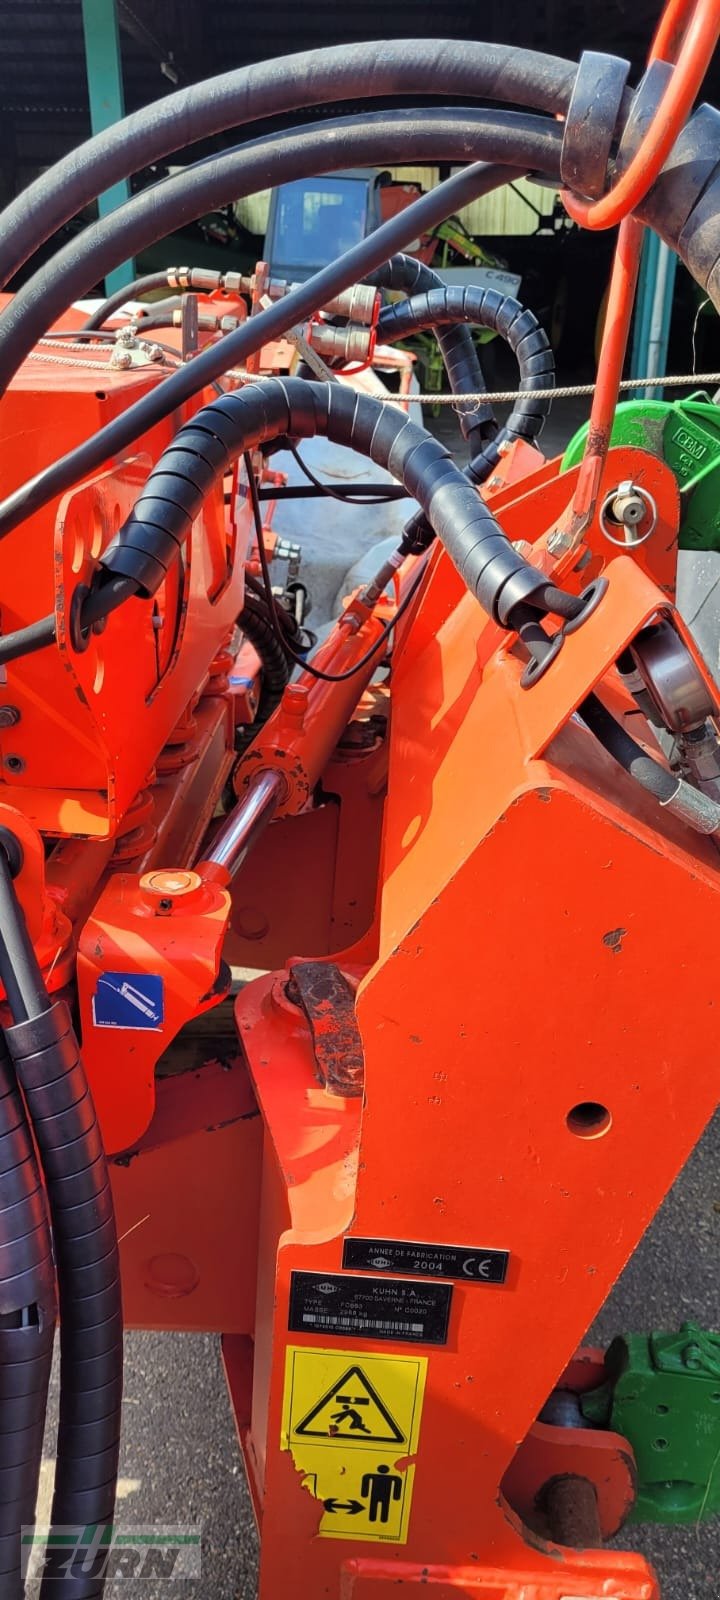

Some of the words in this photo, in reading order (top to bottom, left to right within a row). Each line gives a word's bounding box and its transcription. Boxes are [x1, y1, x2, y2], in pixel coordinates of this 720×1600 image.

[495, 274, 519, 285] 490
[677, 432, 704, 458] CBM
[395, 1249, 405, 1257] DE
[406, 1250, 457, 1261] FABRICATION
[413, 1260, 443, 1271] 2004
[462, 1258, 492, 1277] CE
[372, 1287, 398, 1296] KUHN
